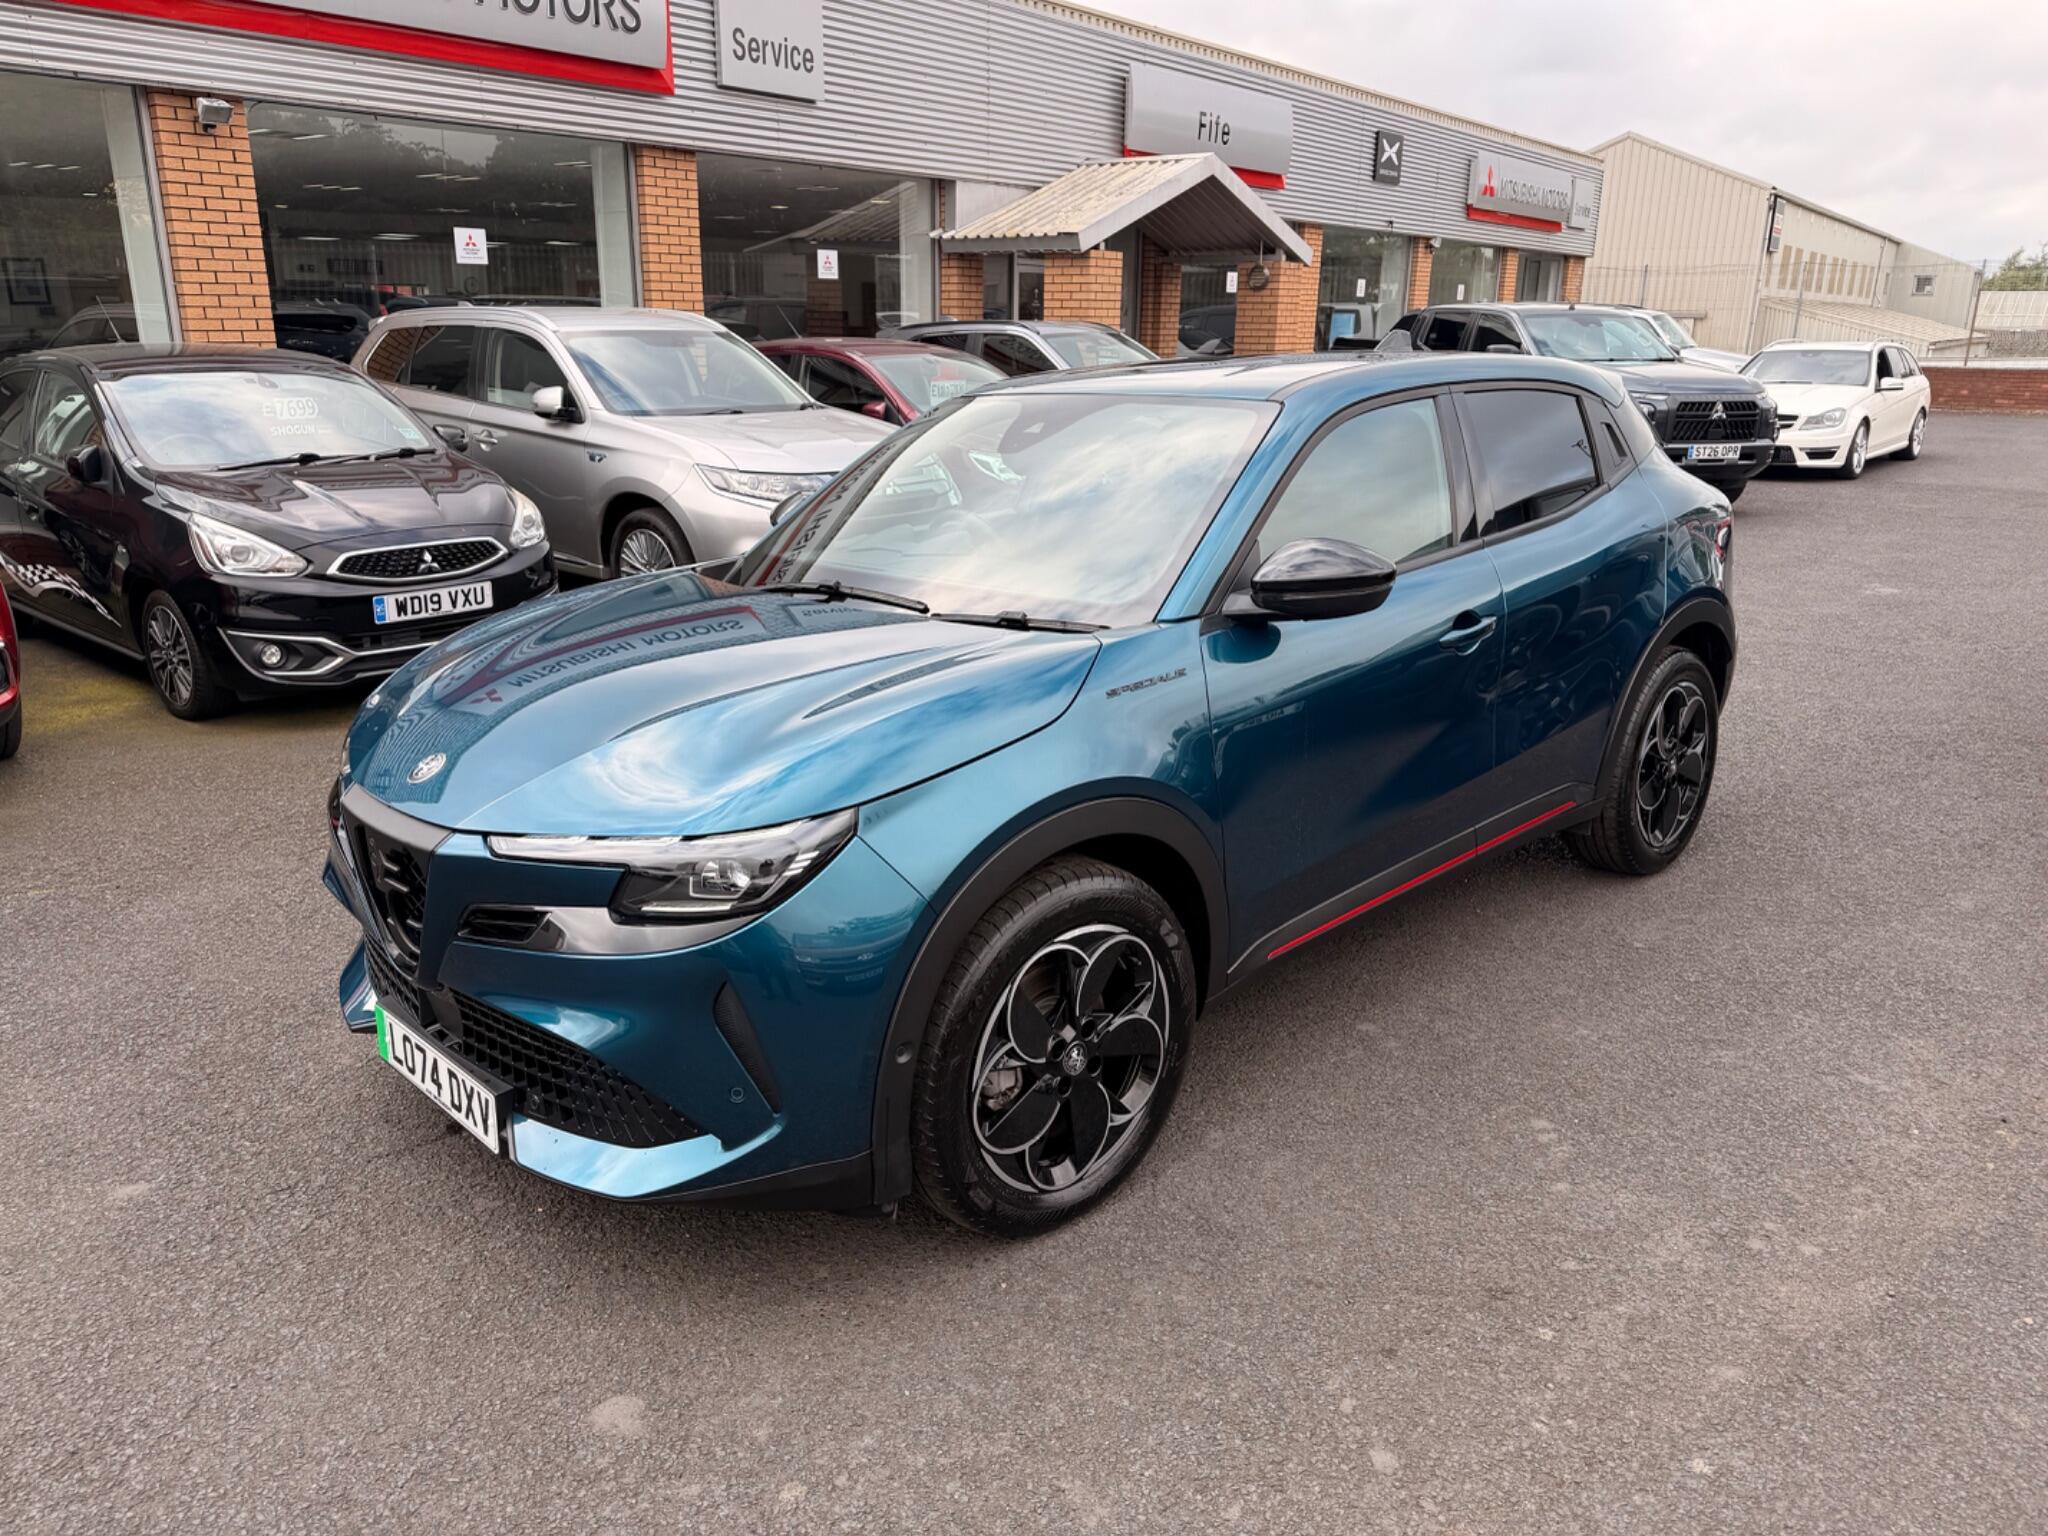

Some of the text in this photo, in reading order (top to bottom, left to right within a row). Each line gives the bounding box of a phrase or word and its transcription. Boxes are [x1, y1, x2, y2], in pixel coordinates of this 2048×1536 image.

[732, 26, 815, 74] Service
[1197, 111, 1231, 146] Fife
[395, 593, 442, 617] WD19
[448, 586, 485, 609] VXU
[447, 1067, 489, 1137] DXV
